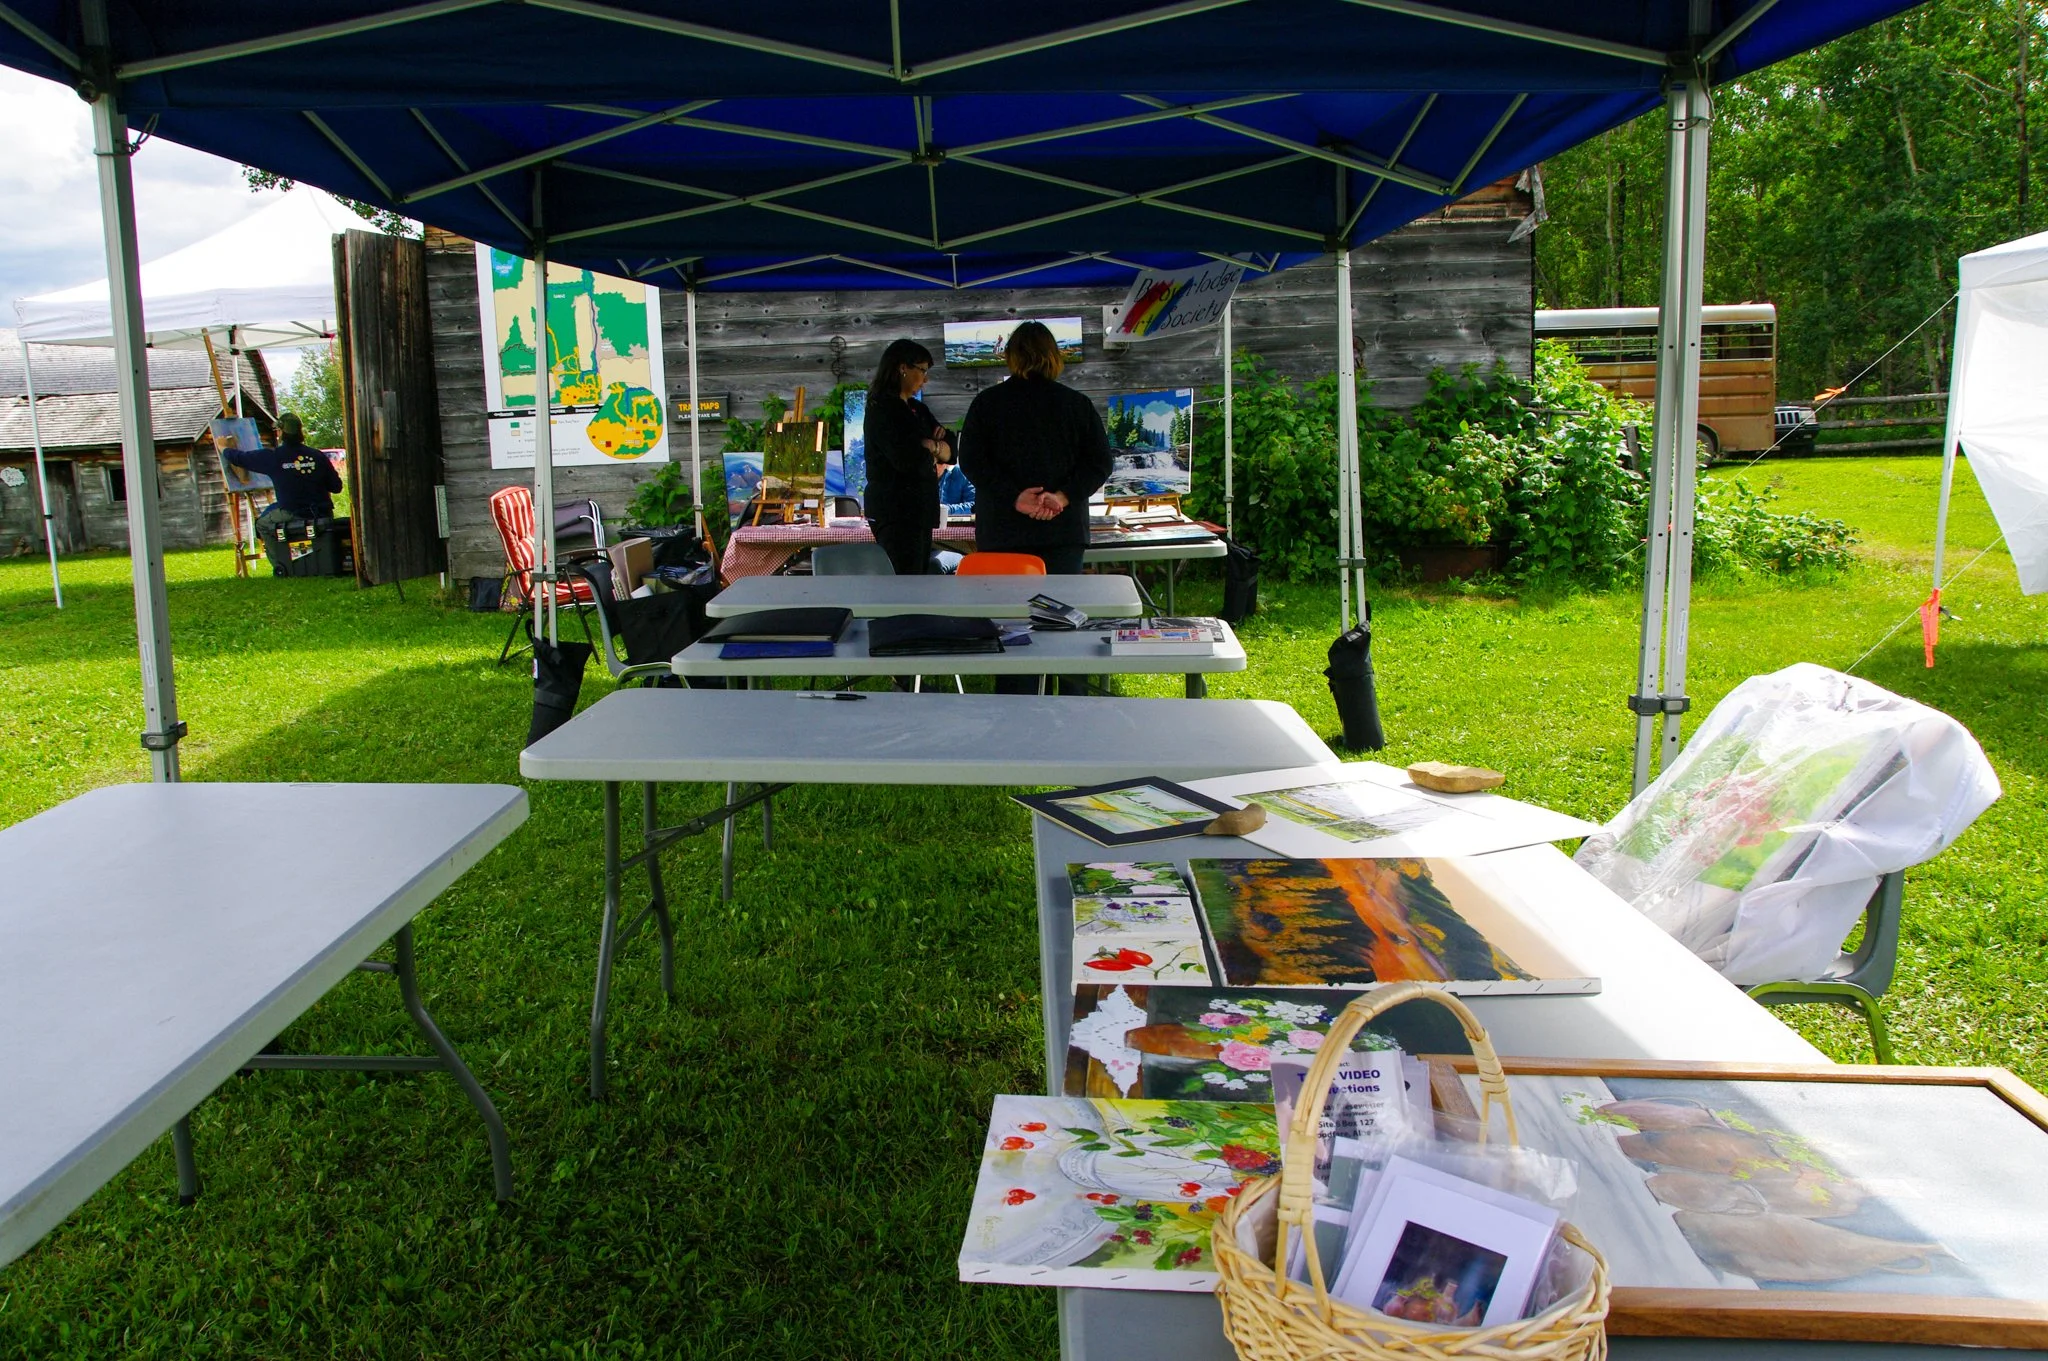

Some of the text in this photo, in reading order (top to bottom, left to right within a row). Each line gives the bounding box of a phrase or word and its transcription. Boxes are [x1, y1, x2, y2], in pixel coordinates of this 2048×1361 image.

[1161, 299, 1225, 330] Society
[700, 401, 720, 411] MAPS
[1339, 1069, 1381, 1080] VIDEO
[1342, 1119, 1357, 1127] Box
